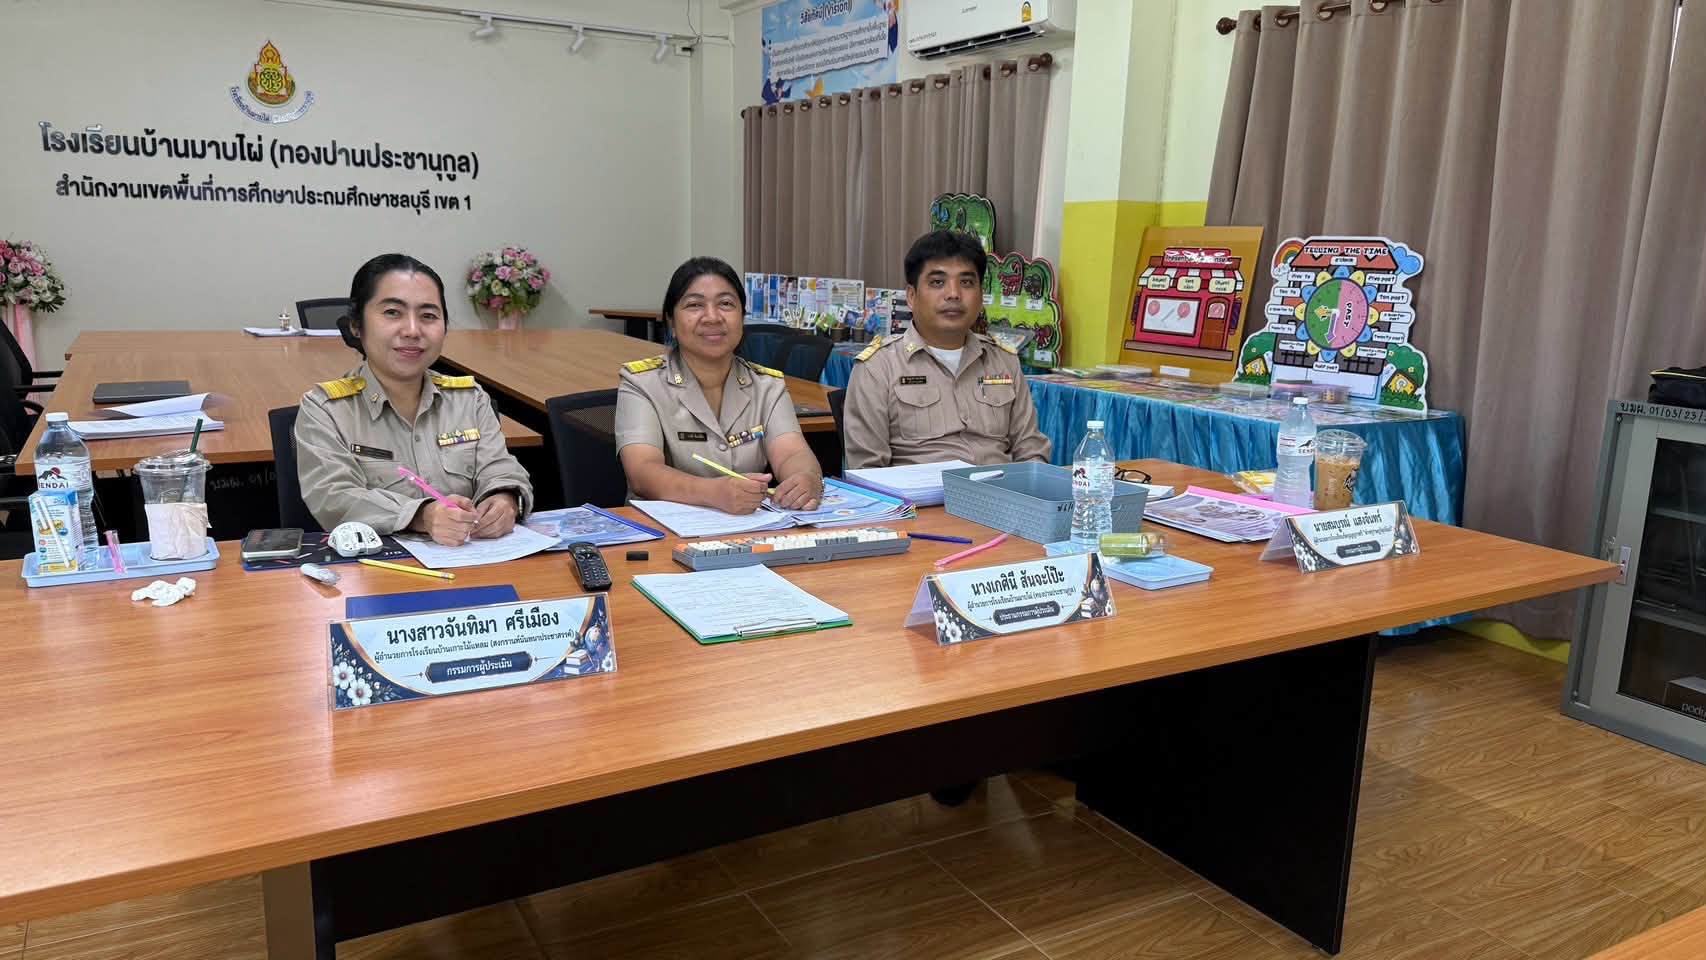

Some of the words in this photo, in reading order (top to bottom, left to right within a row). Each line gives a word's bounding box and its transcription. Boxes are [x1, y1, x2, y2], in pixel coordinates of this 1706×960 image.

[39, 121, 263, 163] โรงเรียนบ้านมาบไผ่
[270, 138, 479, 181] (ทองปานประชานุกูล)
[56, 173, 430, 215] สำนักงานเขตพื้นที่การศึกษาประถมศึกษาชลบุรี
[434, 195, 459, 209] เขต
[463, 195, 471, 210] 1
[387, 615, 497, 645] นางสาวจันทิมา
[505, 606, 560, 631] ศรีเมือง
[447, 659, 512, 676] กรรมการผู้ประเมิน
[1682, 703, 1706, 720] podi
